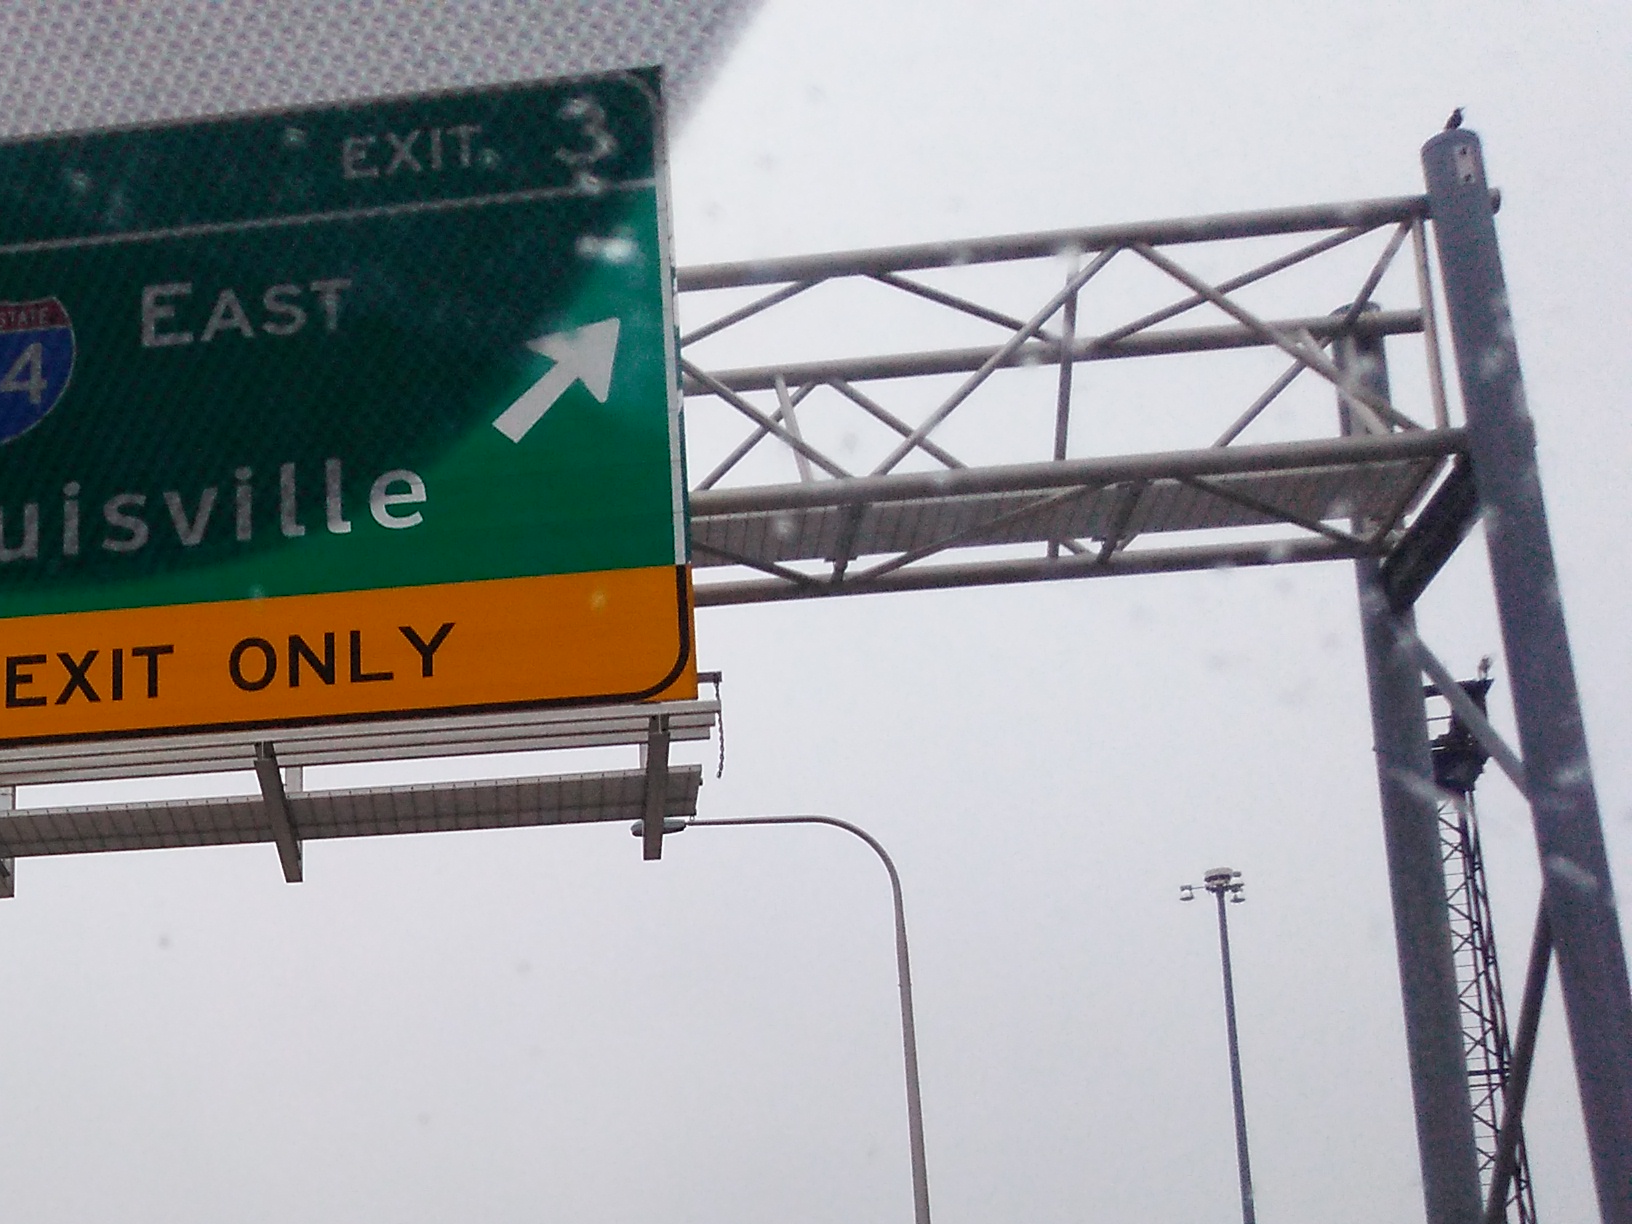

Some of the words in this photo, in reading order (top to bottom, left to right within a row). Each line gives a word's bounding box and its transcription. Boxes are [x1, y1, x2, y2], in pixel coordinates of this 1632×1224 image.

[342, 124, 482, 179] EXIT
[555, 97, 614, 164] 3
[141, 278, 353, 347] EAST
[4, 643, 175, 709] EXIT
[227, 622, 457, 693] ONLY
